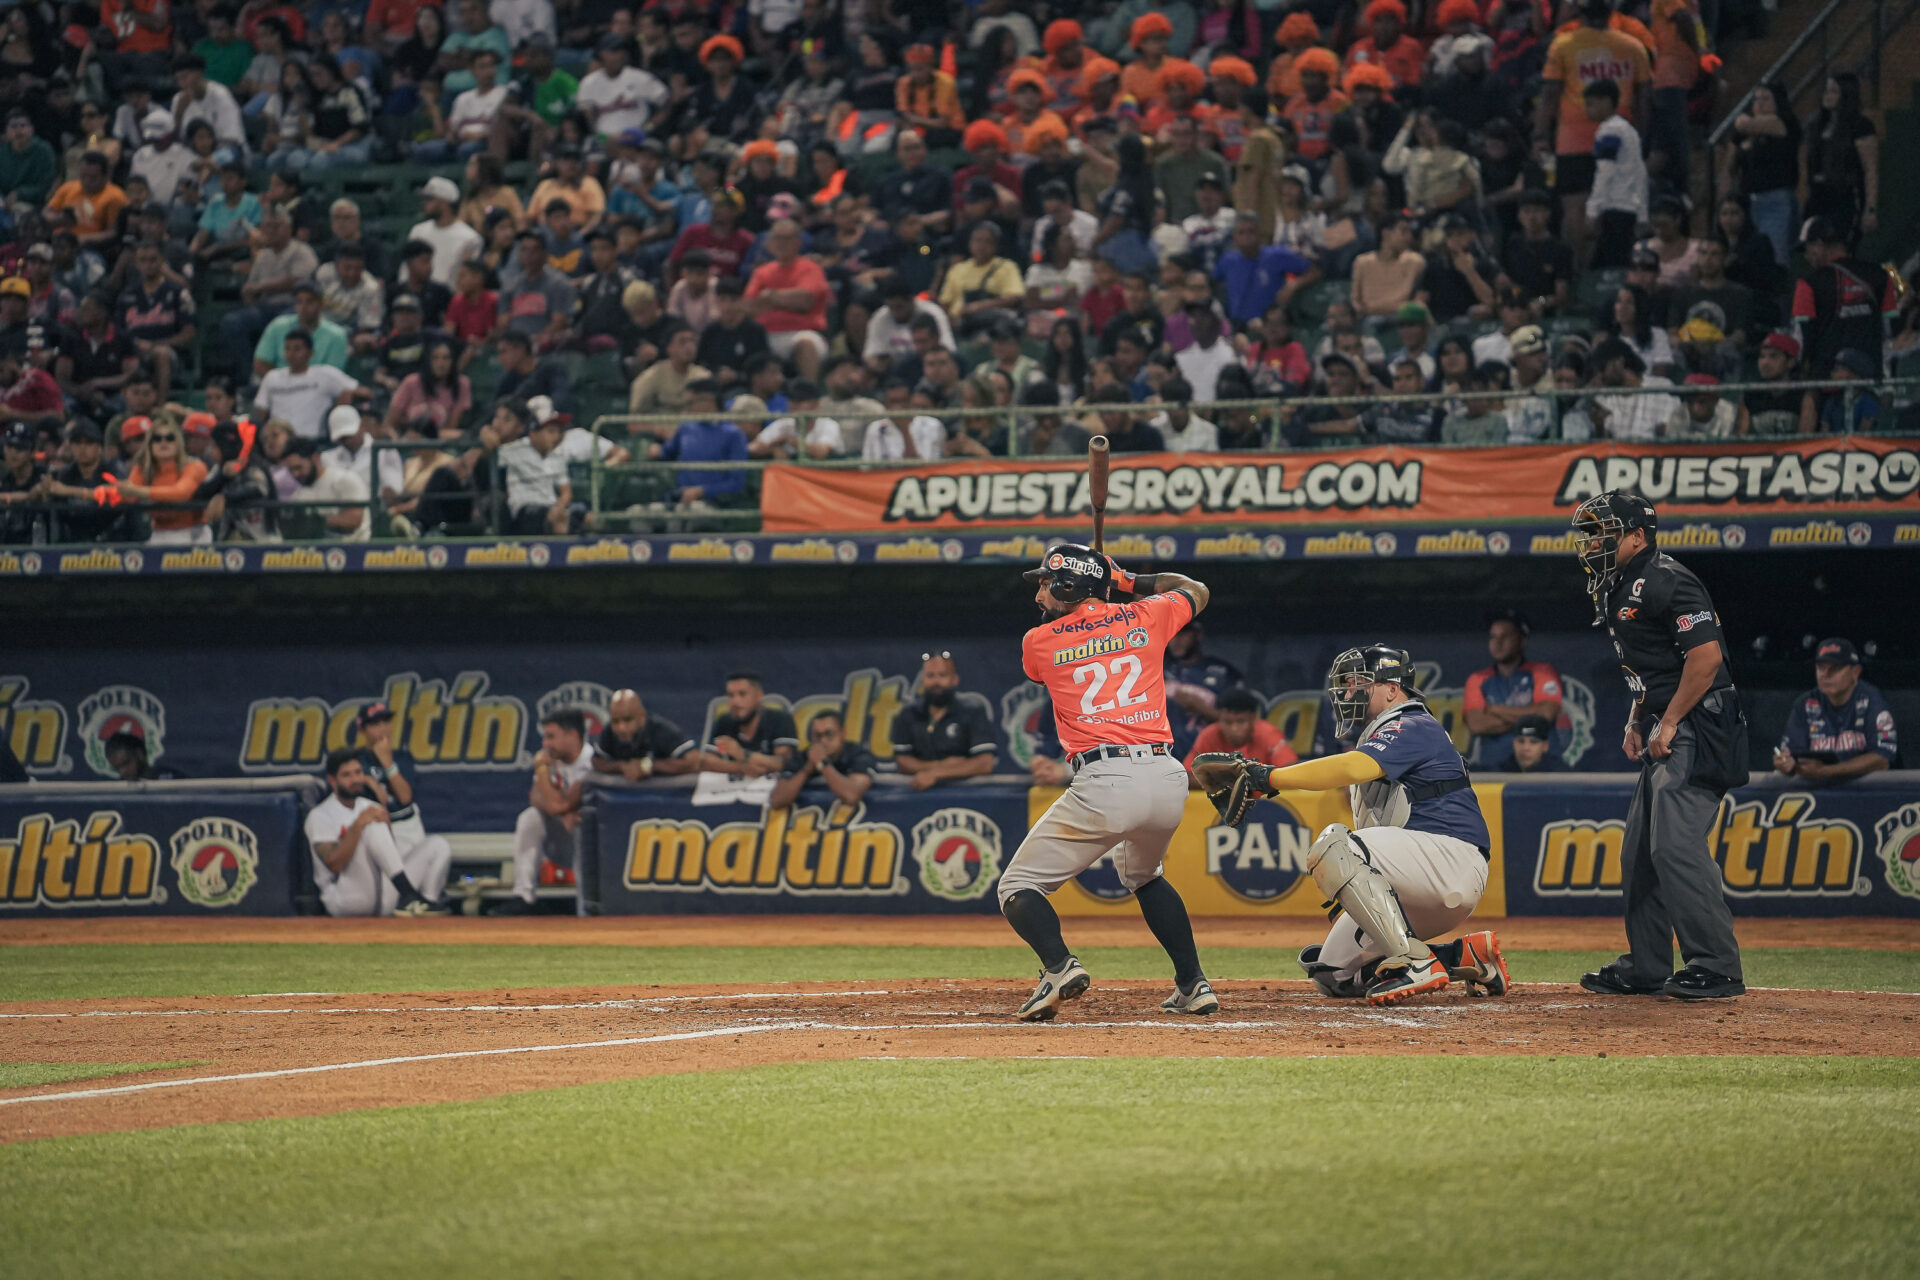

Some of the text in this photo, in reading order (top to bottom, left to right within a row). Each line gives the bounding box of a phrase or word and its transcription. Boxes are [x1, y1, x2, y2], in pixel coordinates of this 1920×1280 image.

[888, 459, 1422, 519] APUESTASROYAL.COM
[1063, 557, 1103, 576] Simple
[1676, 611, 1712, 632] Munchy
[1054, 634, 1125, 666] maltín
[1072, 654, 1148, 715] 22
[627, 805, 902, 890] maltín
